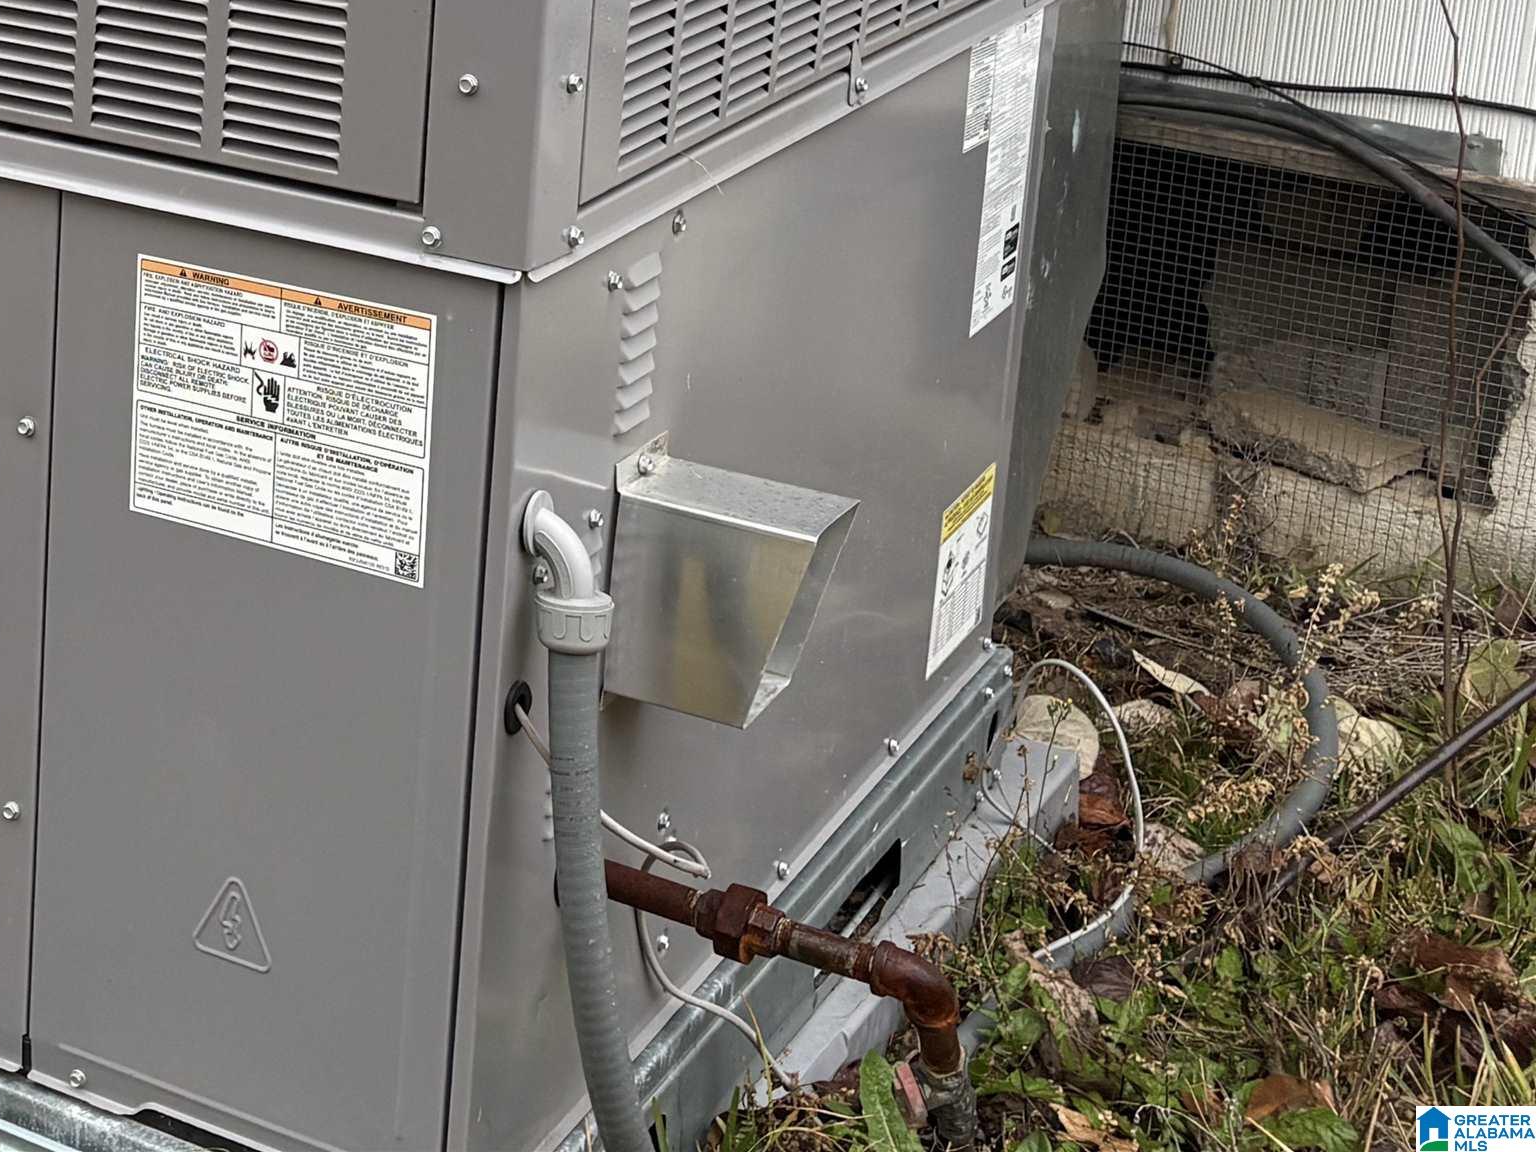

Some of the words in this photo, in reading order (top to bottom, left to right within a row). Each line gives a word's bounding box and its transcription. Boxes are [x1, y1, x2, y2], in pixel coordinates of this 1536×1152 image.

[192, 272, 229, 285] WARNING
[171, 311, 201, 322] EXPLOSION
[203, 318, 225, 327] HAZARD
[337, 302, 407, 323] AVERTISSEMENT
[141, 360, 152, 368] CAN
[153, 363, 172, 373] CAUSE
[175, 368, 194, 378] INJURY
[145, 346, 185, 361] ELECTRICAL
[187, 356, 209, 366] SHOCK
[212, 362, 240, 373] HAZARD
[140, 367, 176, 380] DISCONNECT
[179, 375, 188, 383] ALL
[191, 378, 215, 389] REMOTE
[172, 361, 185, 369] RISK
[197, 367, 225, 378] ELECTRIC
[140, 373, 167, 384] ELECTRIC
[169, 380, 190, 390] POWER
[192, 385, 220, 397] SUPPLIES
[222, 392, 246, 403] BEFORE
[316, 386, 342, 397] RISQUE
[286, 401, 324, 415] BLESSURES
[326, 410, 335, 418] OU
[326, 395, 349, 406] RISQUE
[287, 409, 310, 420] TOUTES
[312, 415, 324, 423] LES
[326, 418, 376, 435] ALIMENTATIONS
[328, 403, 358, 416] POUVANT
[360, 410, 386, 422] CAUSER
[389, 417, 401, 426] DES
[236, 415, 265, 427] SERVICE
[267, 423, 315, 439] INFORMATION
